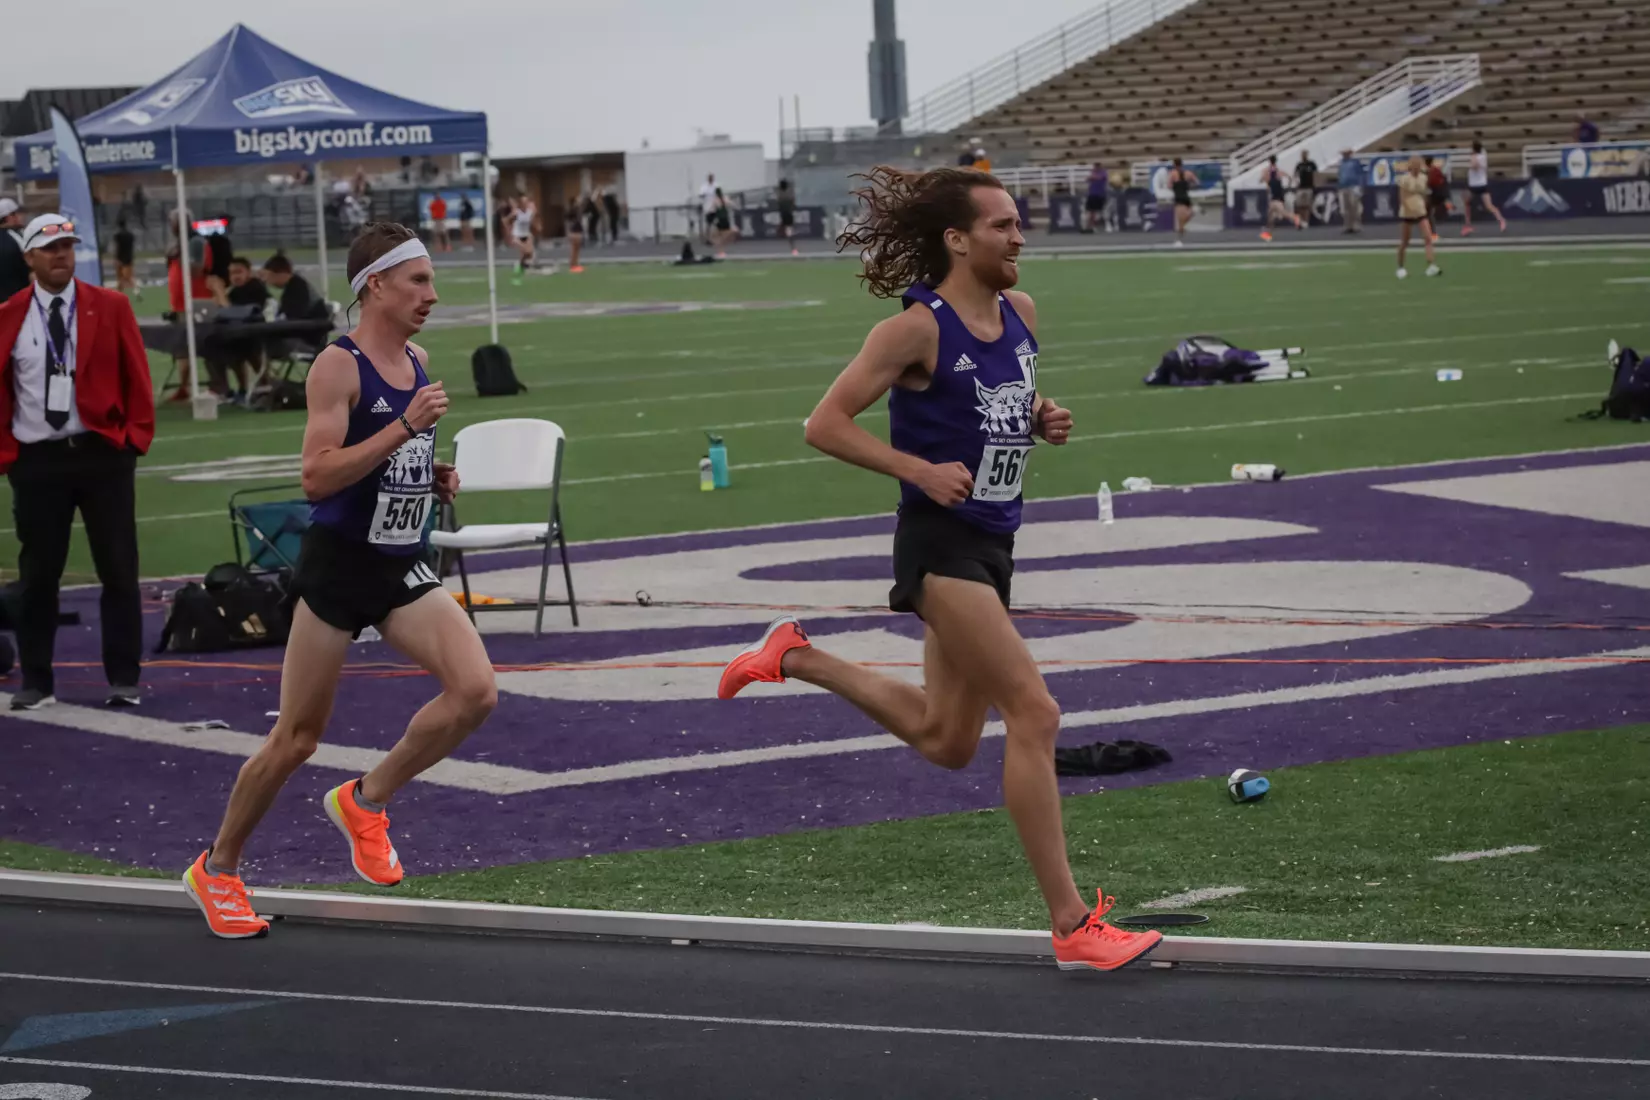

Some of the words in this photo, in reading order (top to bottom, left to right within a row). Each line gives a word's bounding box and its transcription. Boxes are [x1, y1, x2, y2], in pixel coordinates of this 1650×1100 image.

[81, 138, 156, 162] onference
[234, 122, 433, 157] bigskyconf.com
[954, 363, 977, 371] adidas
[382, 496, 426, 531] 550
